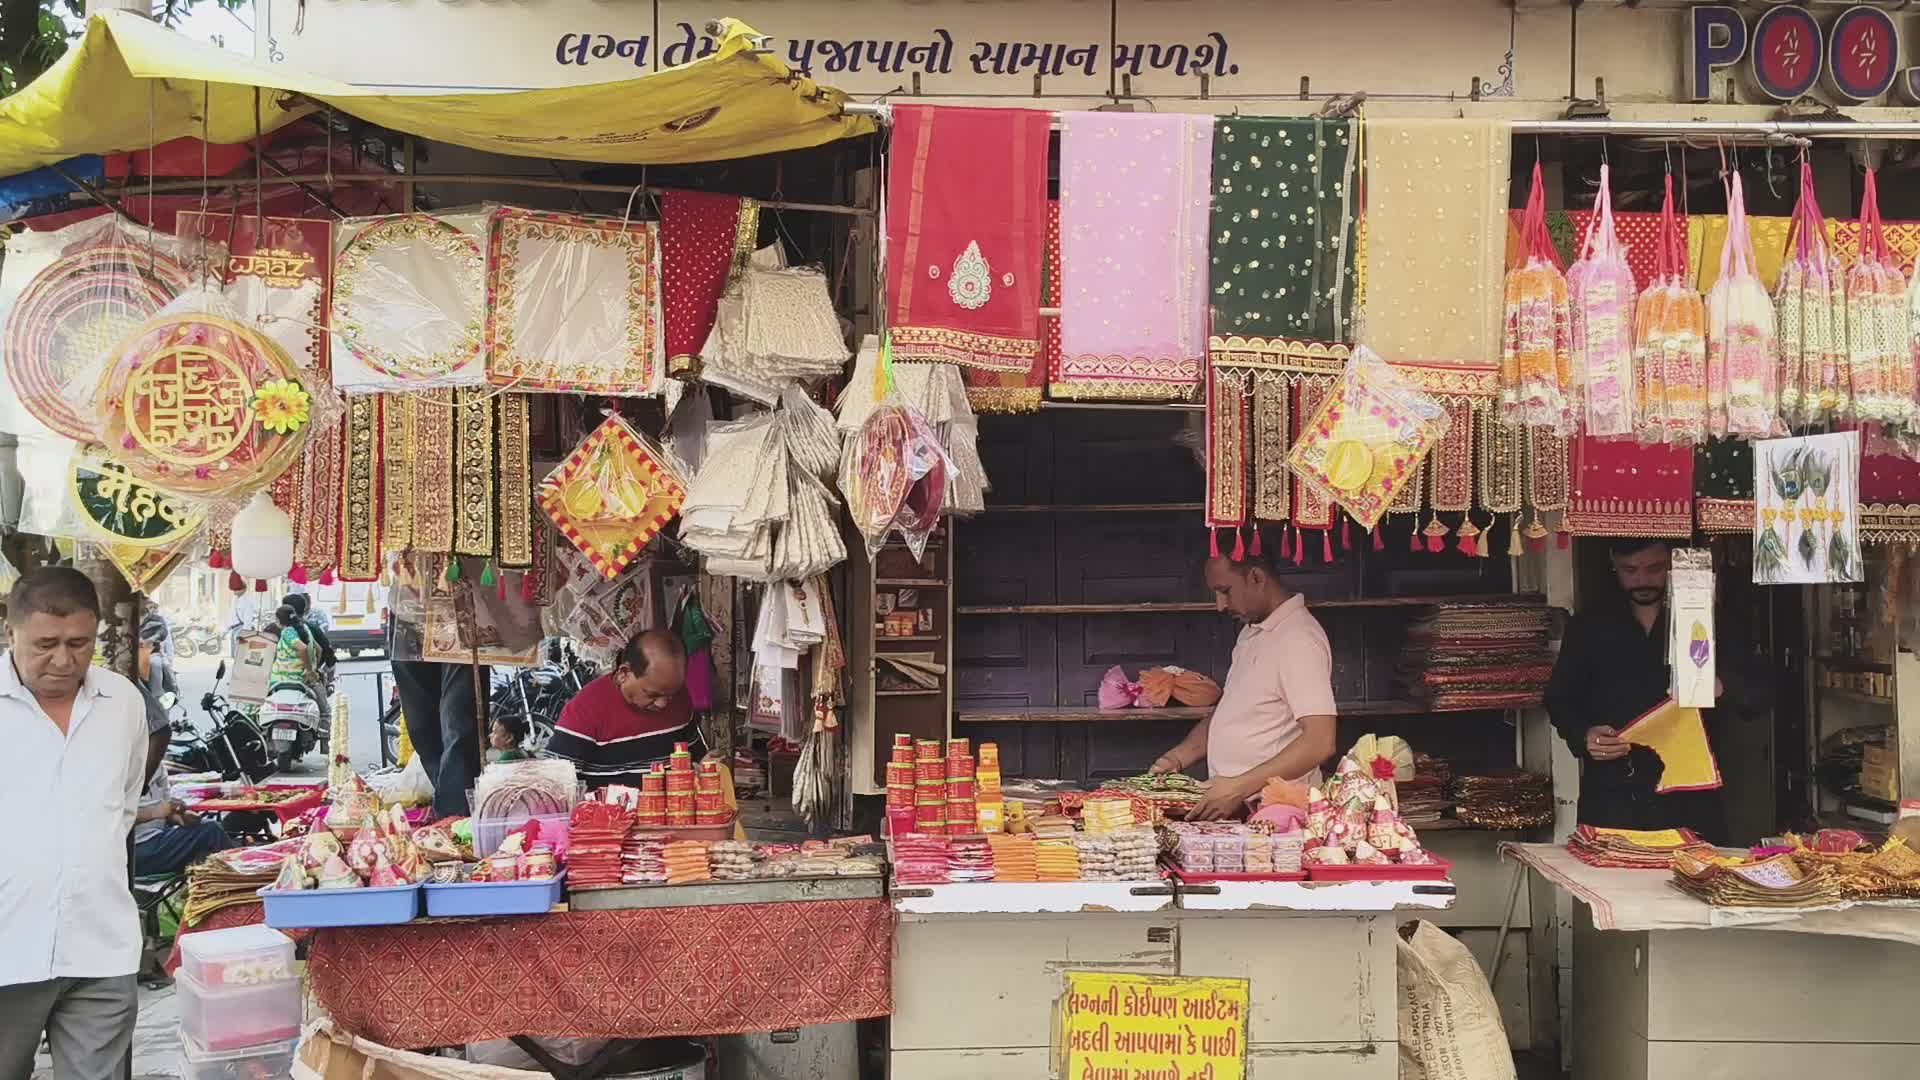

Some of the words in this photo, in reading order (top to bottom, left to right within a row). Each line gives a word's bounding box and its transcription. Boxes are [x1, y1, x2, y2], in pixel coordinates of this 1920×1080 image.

[969, 42, 1099, 75] સામાન
[1691, 5, 1920, 101] POO
[1123, 986, 1177, 1018] કોઈપણ
[1184, 1024, 1197, 1056] કે
